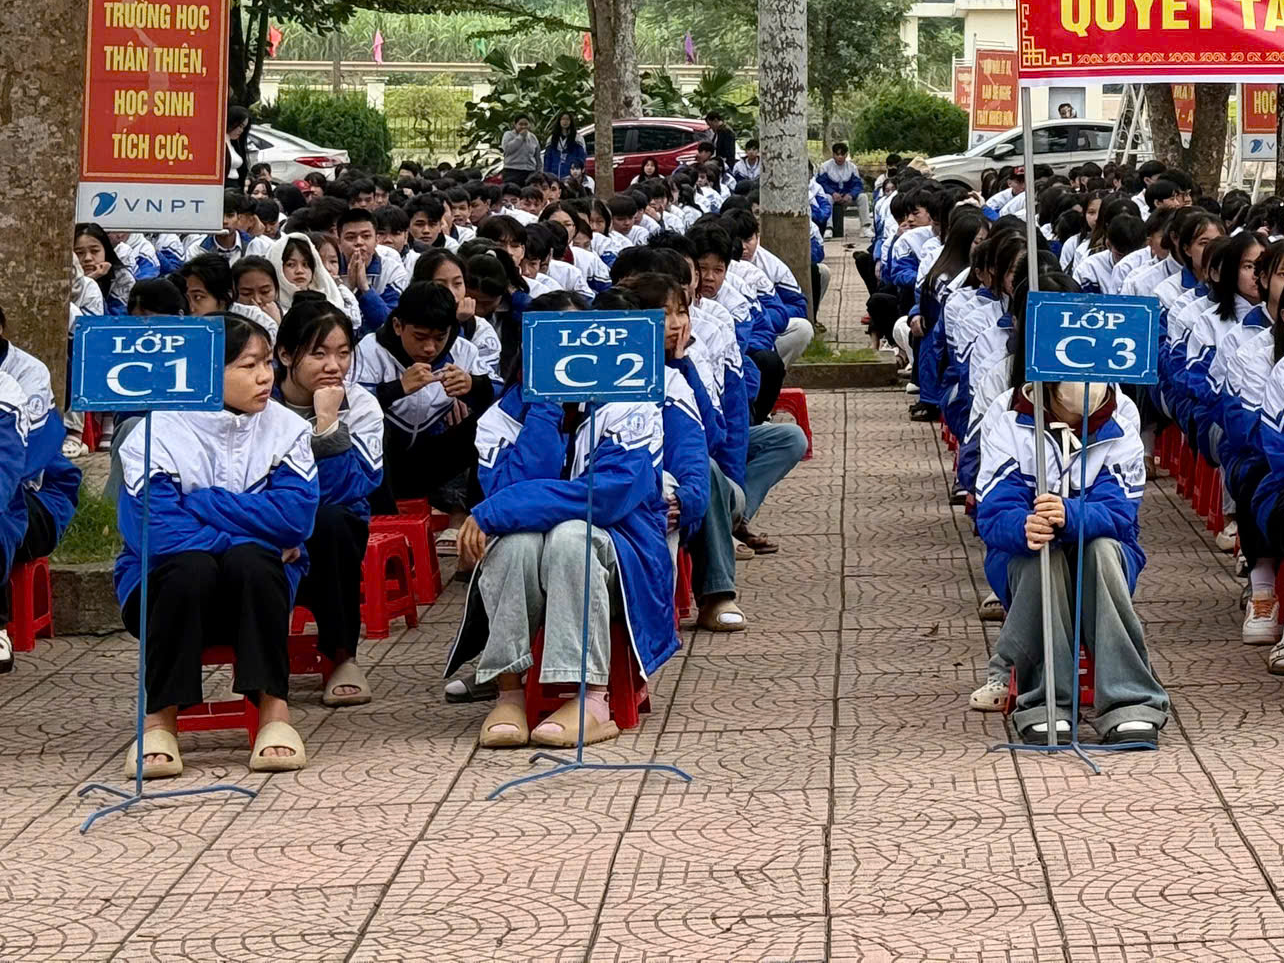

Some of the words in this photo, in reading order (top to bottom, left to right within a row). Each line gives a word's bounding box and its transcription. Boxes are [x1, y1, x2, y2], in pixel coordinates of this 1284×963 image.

[175, 4, 210, 35] HỌC
[103, 41, 149, 72] THÂN
[153, 42, 207, 79] THIỆN,
[114, 90, 149, 121] HỌC
[153, 90, 195, 117] SINH
[112, 128, 150, 159] TÍCH
[154, 132, 194, 165] CỰC.
[124, 198, 205, 213] VNPT
[1060, 307, 1126, 330] LỚP
[112, 330, 185, 354] LỚP
[558, 323, 628, 347] LỚP
